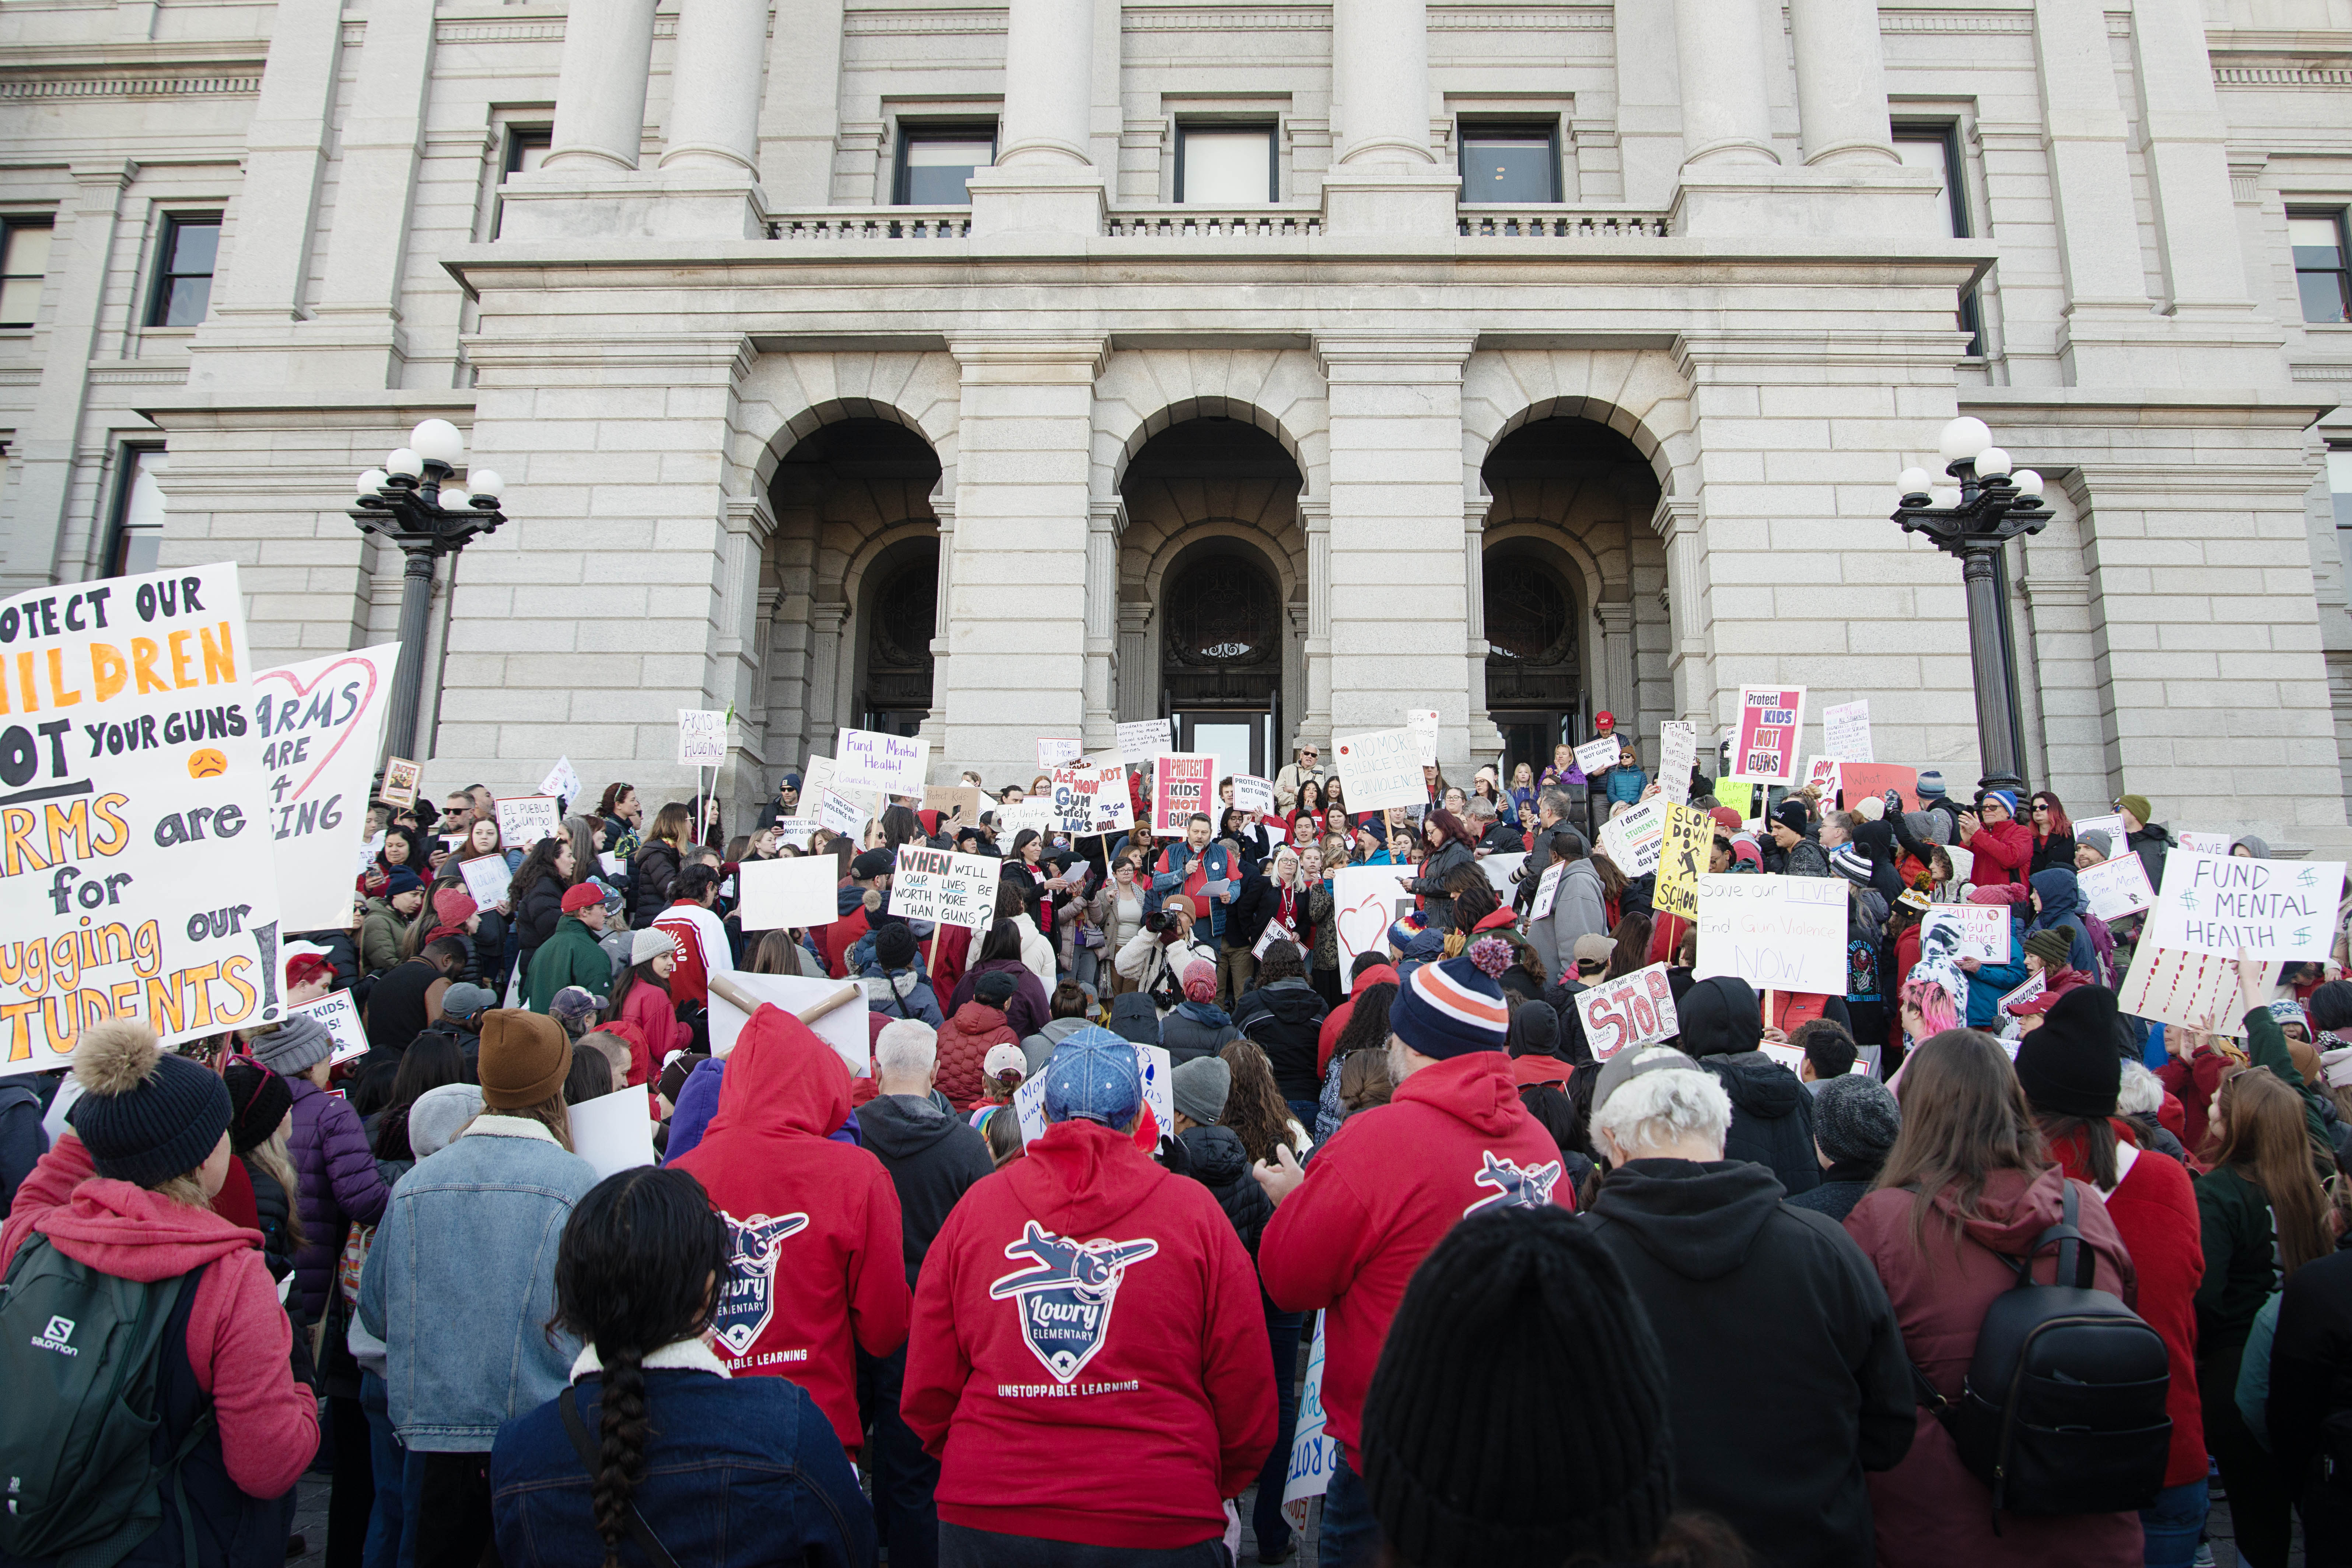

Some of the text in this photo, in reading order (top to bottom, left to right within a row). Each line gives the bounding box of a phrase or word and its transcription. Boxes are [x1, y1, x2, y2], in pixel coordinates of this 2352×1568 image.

[136, 577, 206, 622] OUR
[1749, 694, 1778, 705] Protect
[256, 682, 360, 738] ARMS
[1764, 711, 1792, 723] KIDS
[1847, 713, 1867, 721] STUDENTS
[682, 712, 725, 730] ARMS are
[1408, 715, 1424, 723] Safe
[84, 715, 159, 758] YOUR
[164, 704, 247, 745] GUNS
[1415, 727, 1434, 737] hools
[1756, 730, 1779, 747] NOT
[262, 736, 311, 771] ARE
[685, 740, 724, 757] HUGGING
[847, 732, 917, 758] Fund Mental
[1040, 743, 1053, 756] NOT
[1354, 733, 1416, 758] NO MORE
[1577, 744, 1600, 755] PROTECT
[1596, 746, 1612, 755] GUNS!
[1663, 758, 1676, 766] MUST
[1666, 747, 1689, 763] FAMILIES
[1749, 754, 1778, 771] GUNS
[865, 754, 902, 775] Health!
[1172, 759, 1203, 776] PROTECT
[1344, 754, 1418, 776] SILENCE END
[1813, 760, 1833, 778] AM
[839, 771, 878, 789] Counselors,
[885, 780, 896, 790] not
[1235, 778, 1272, 792] PROTECT KIDS,
[1663, 772, 1674, 782] SAFE
[1848, 772, 1880, 785] What
[270, 774, 292, 803] 4
[927, 790, 946, 800] Protect
[1074, 779, 1099, 794] NOW
[1170, 785, 1200, 796] KIDS
[1254, 789, 1268, 798] GUNS!
[504, 804, 550, 815] EL PUEBLO
[824, 801, 847, 819] VIOLENCE
[833, 797, 854, 814] END GUN
[1054, 805, 1091, 820] Safety
[1169, 799, 1199, 810] NOT
[270, 794, 342, 840] ING
[522, 816, 553, 827] UNIDO!
[1020, 810, 1048, 818] Unite
[1625, 807, 1650, 824] dream
[1673, 807, 1711, 829] SLOW
[1008, 822, 1037, 831] SAFE
[1062, 818, 1092, 832] LAWS
[1625, 818, 1658, 839] STUDENTS
[0, 792, 246, 878] RMS are
[1673, 824, 1708, 845] DOWN
[1635, 846, 1649, 856] will
[900, 849, 987, 878] WHEN WILL
[1638, 856, 1652, 867] day
[2092, 857, 2138, 881] one MORE
[2194, 860, 2269, 890] FUND
[48, 866, 133, 915] for
[905, 874, 992, 896] OUR LIVES BE
[1701, 876, 1847, 903] Save our LIVES
[2091, 887, 2112, 897] One
[895, 887, 967, 906] WORTH MORE
[903, 903, 933, 917] THAN
[1977, 909, 1984, 919] A
[2216, 893, 2317, 918] MENTAL
[1277, 930, 1288, 940] END
[1701, 914, 1835, 939] End Gun Violence
[2187, 920, 2274, 948] HEALTH
[0, 904, 252, 998] ugging our
[1848, 940, 1873, 953] BITE THE
[1736, 945, 1807, 983] NOW.
[313, 1000, 349, 1017] KIDS,
[1588, 971, 1668, 1059] STOP
[1030, 1295, 1099, 1330] Lowry
[1033, 1329, 1093, 1341] ELEMENTARY
[31, 1335, 78, 1357] salomon
[757, 1349, 807, 1365] LEARNING
[998, 1380, 1139, 1397] UNSTOPPABLE LEARNING
[10, 1477, 20, 1487] 20
